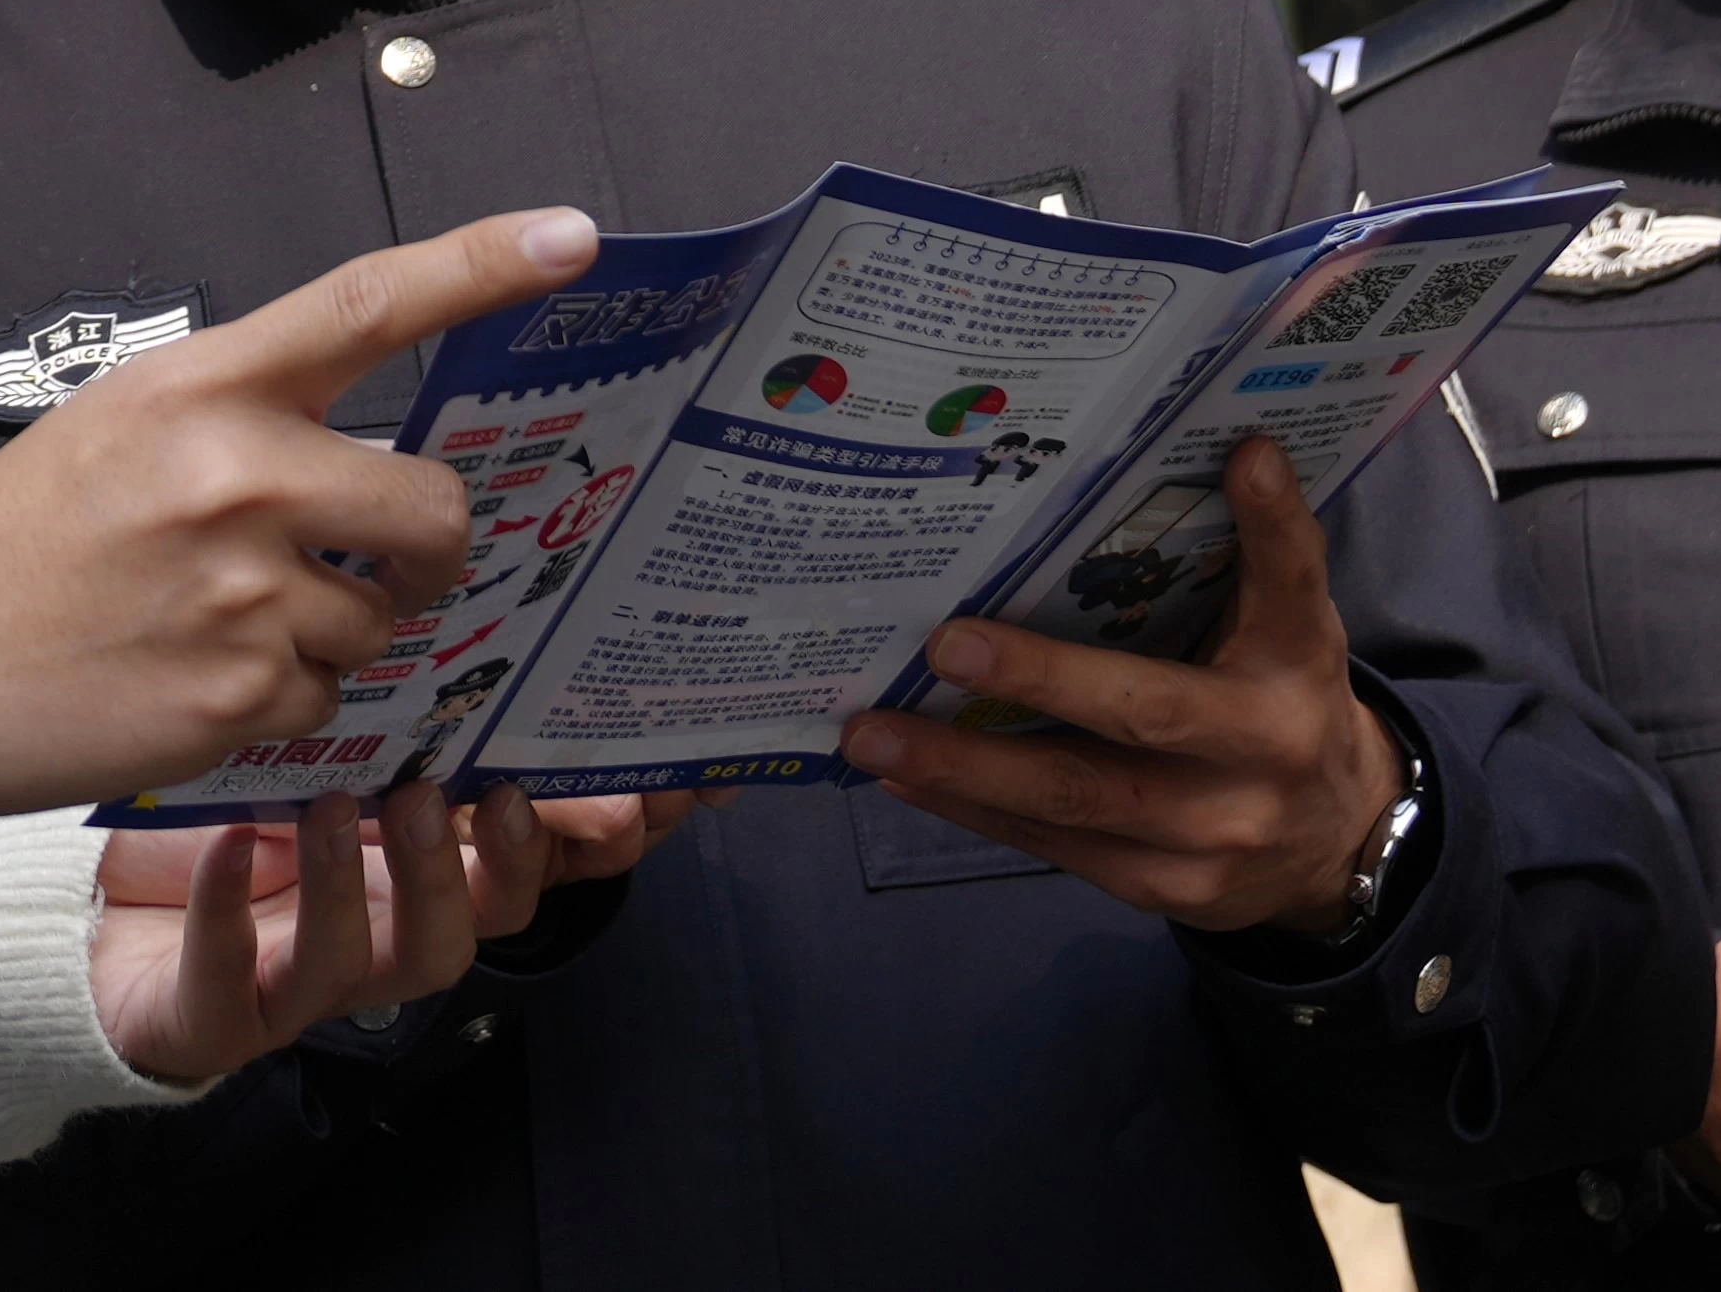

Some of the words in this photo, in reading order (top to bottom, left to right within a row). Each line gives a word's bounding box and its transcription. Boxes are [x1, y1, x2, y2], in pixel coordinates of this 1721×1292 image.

[790, 332, 868, 359] 案件数占比
[40, 346, 111, 376] POLICE
[1239, 368, 1320, 389] 96110
[721, 425, 944, 473] 常见诈骗类型引流手段
[700, 759, 804, 782] 96110
